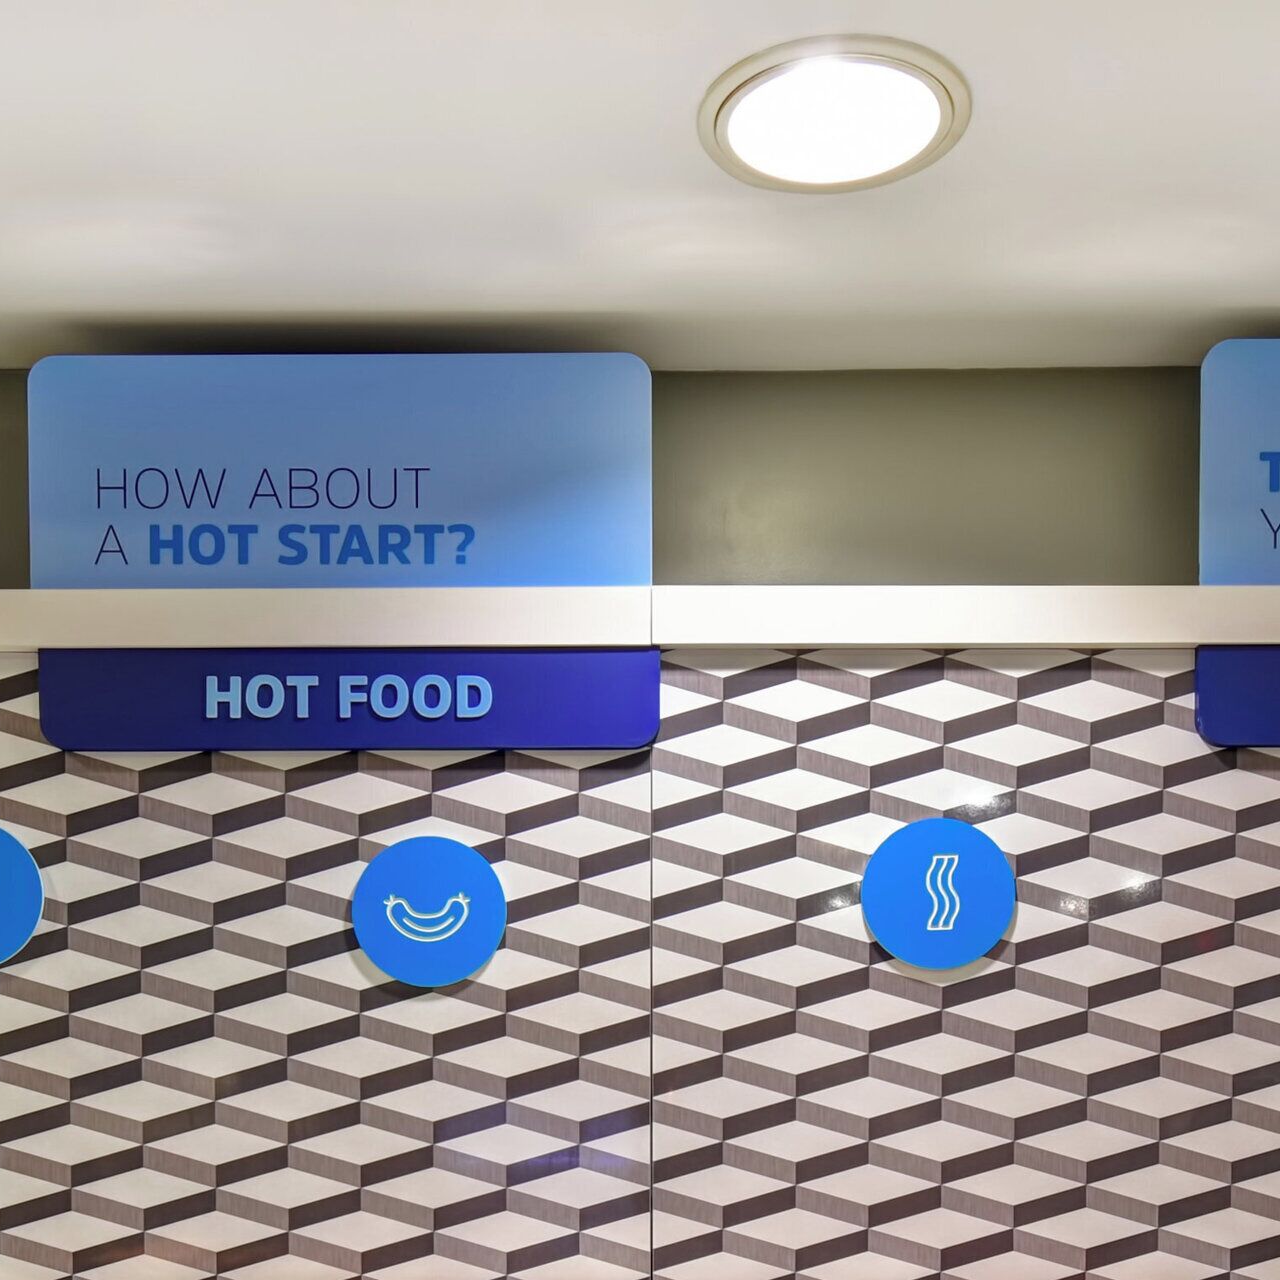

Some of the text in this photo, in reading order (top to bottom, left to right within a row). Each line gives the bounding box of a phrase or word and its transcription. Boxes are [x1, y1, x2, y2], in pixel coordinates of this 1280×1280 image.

[96, 467, 431, 509] HOW ABOUT
[95, 523, 476, 566] A HOT START?
[205, 673, 494, 720] HOT FOOD
